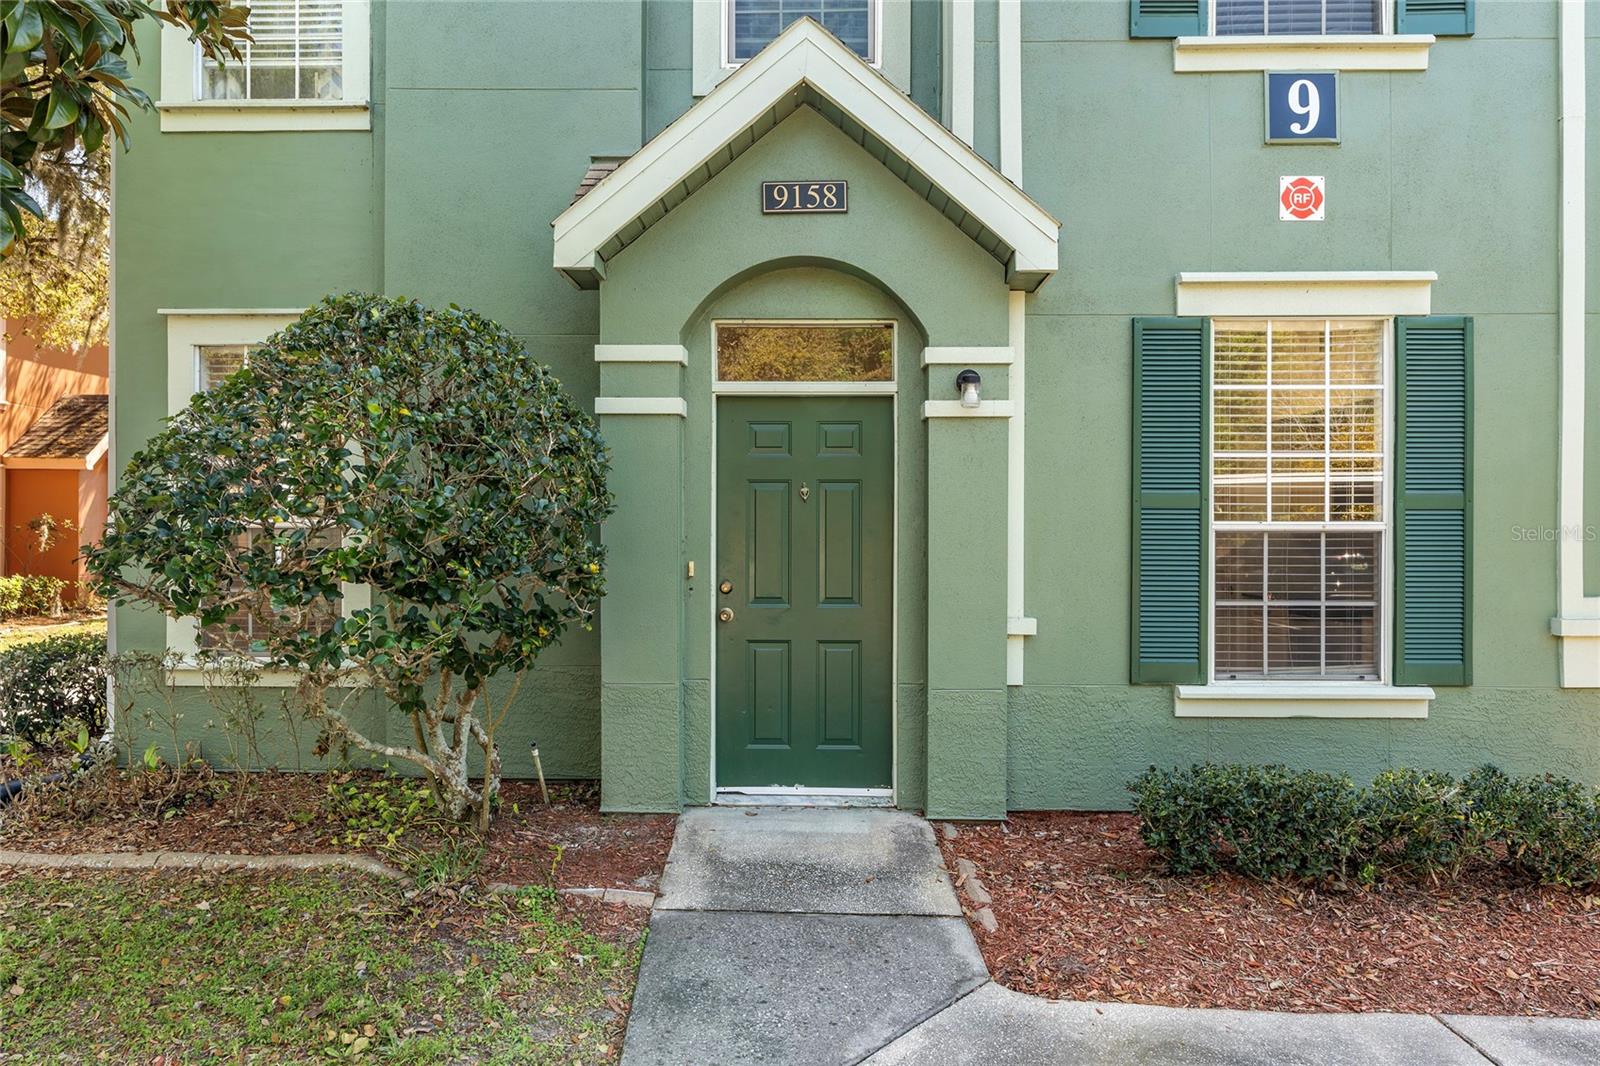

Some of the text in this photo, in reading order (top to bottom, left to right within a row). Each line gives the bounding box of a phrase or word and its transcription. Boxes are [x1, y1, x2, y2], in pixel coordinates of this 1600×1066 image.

[1288, 79, 1320, 134] 9
[773, 184, 837, 208] 9158
[1294, 193, 1311, 204] RF
